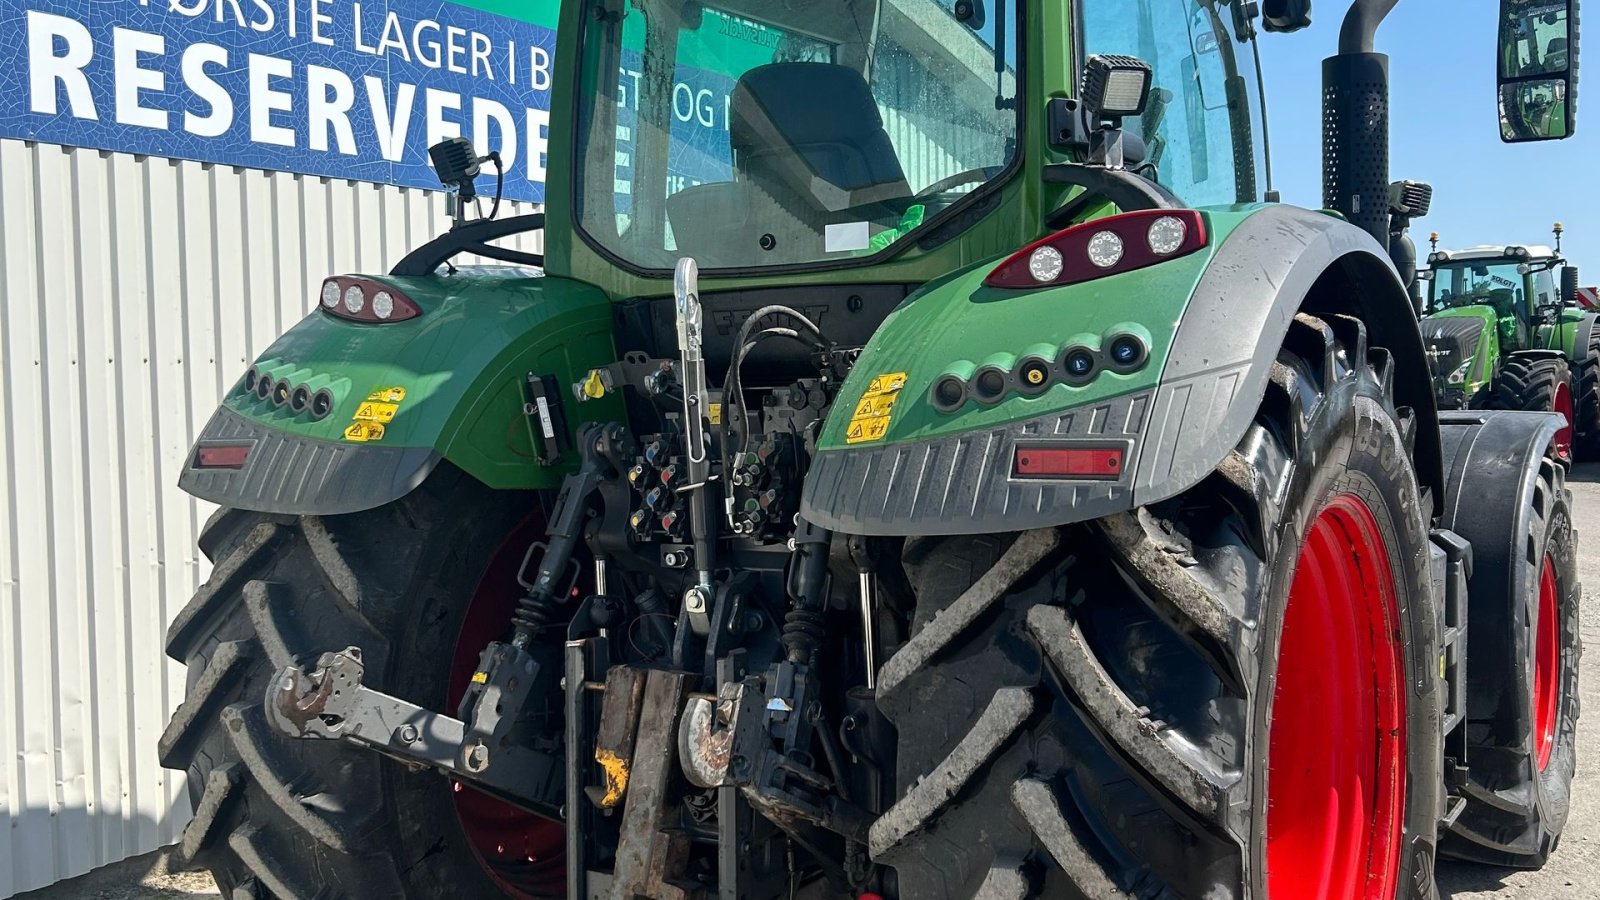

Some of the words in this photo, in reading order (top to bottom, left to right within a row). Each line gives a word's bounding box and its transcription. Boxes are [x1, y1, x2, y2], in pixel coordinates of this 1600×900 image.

[355, 2, 494, 80] LAGER
[509, 40, 515, 85] I
[672, 82, 714, 128] OG
